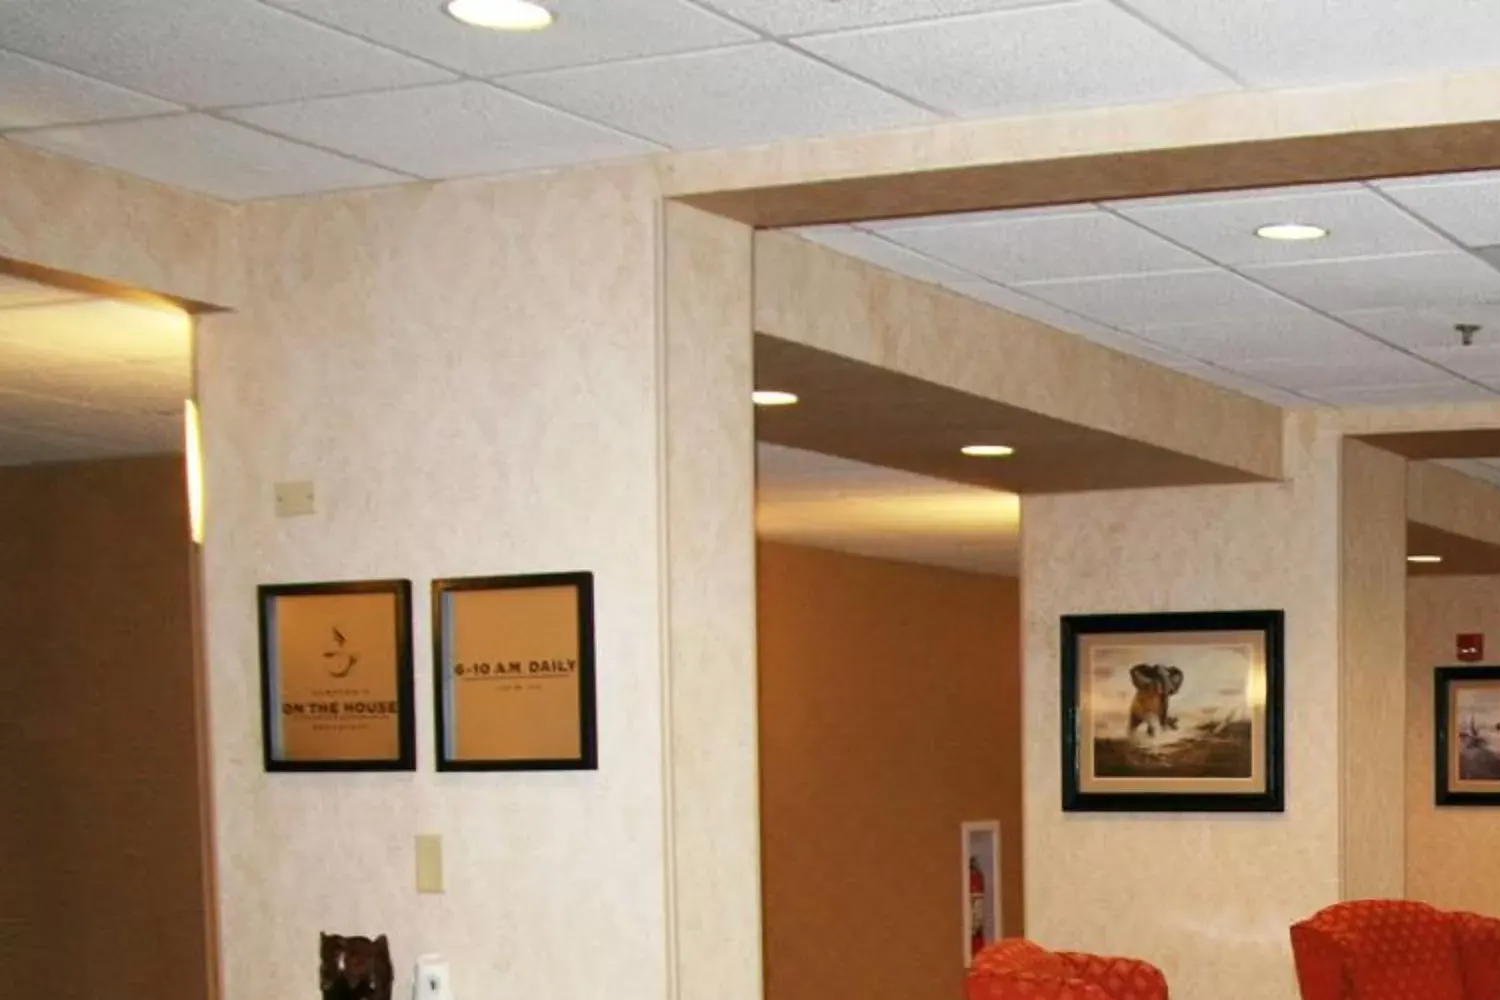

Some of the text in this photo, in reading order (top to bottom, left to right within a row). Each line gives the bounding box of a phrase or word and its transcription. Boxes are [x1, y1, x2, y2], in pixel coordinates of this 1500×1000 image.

[454, 661, 490, 676] 6-10
[528, 658, 576, 673] DAILY
[282, 700, 399, 716] ON THE HOUSE
